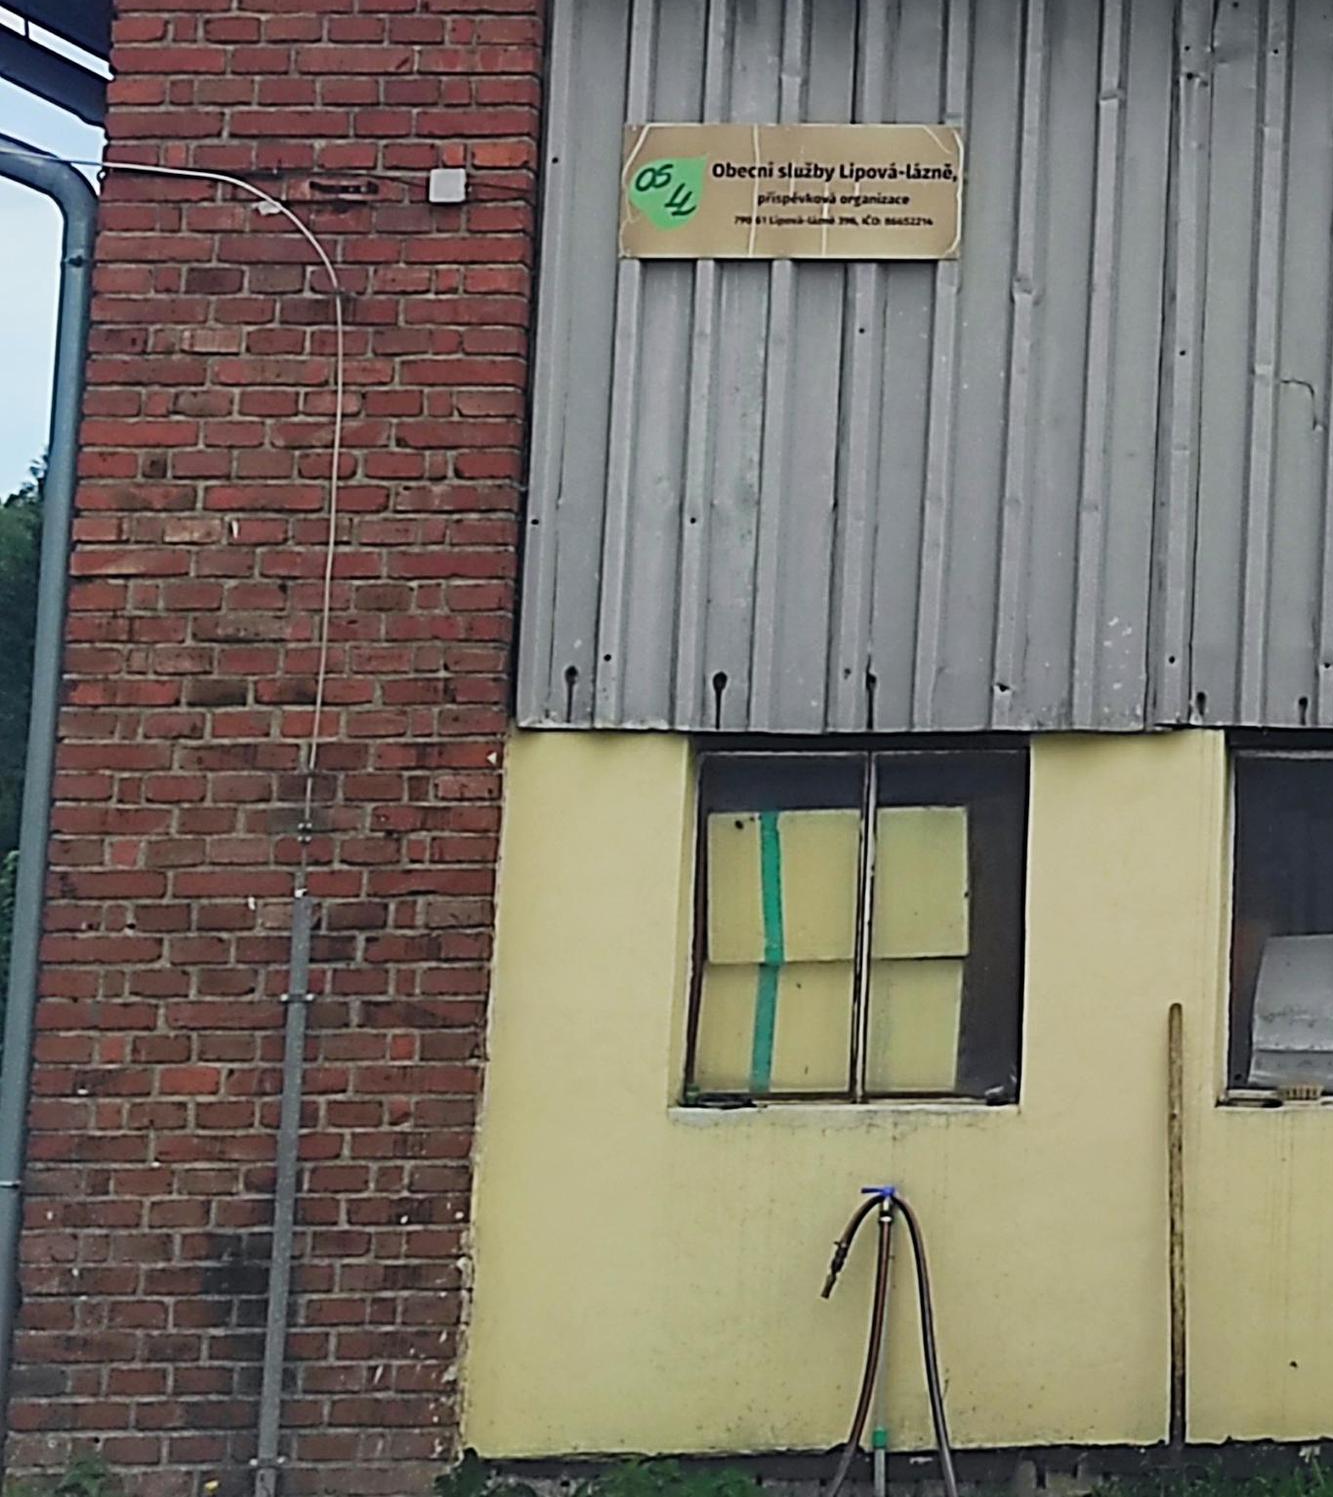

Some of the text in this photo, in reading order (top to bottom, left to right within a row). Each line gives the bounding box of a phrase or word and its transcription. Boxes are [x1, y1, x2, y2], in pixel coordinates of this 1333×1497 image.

[712, 161, 958, 183] Obecní služby Lipová-lázně,
[757, 191, 910, 207] příspěvková organizace
